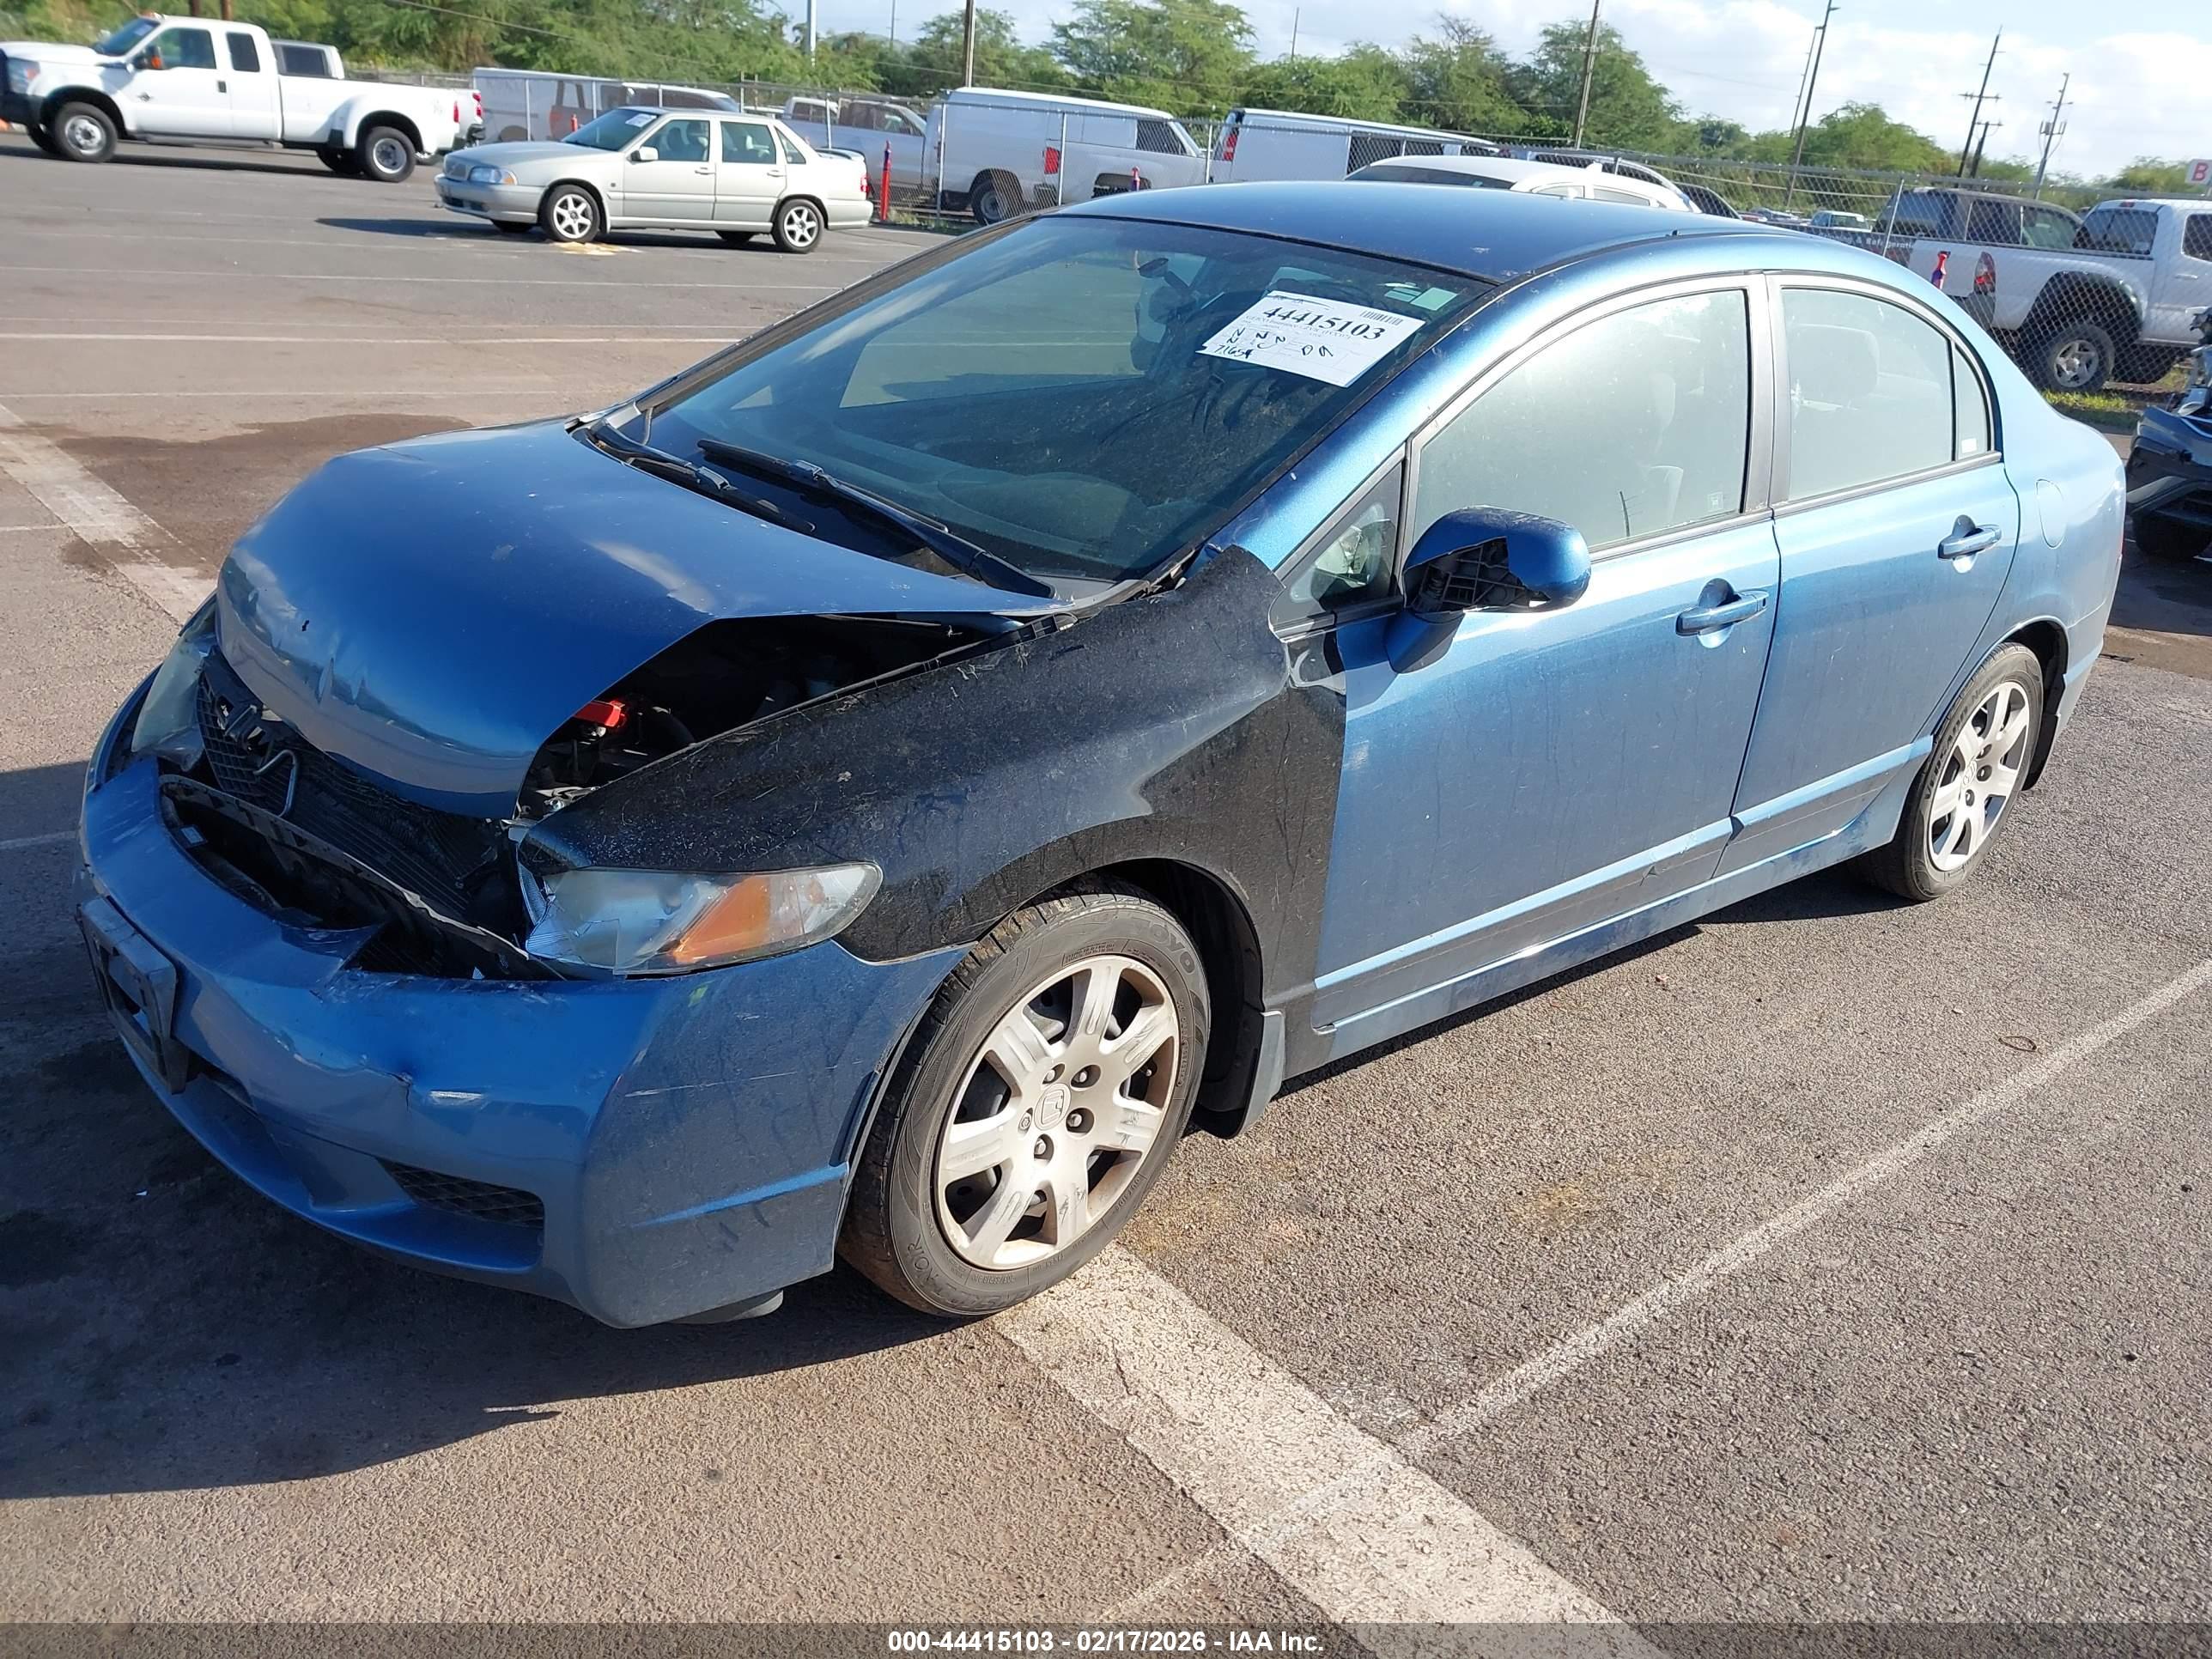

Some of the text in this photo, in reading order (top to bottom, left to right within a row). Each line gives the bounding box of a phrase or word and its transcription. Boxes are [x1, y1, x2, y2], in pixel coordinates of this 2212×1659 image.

[2191, 162, 2209, 181] B
[1263, 307, 1386, 341] 44415103
[1130, 915, 1195, 974] TOYO
